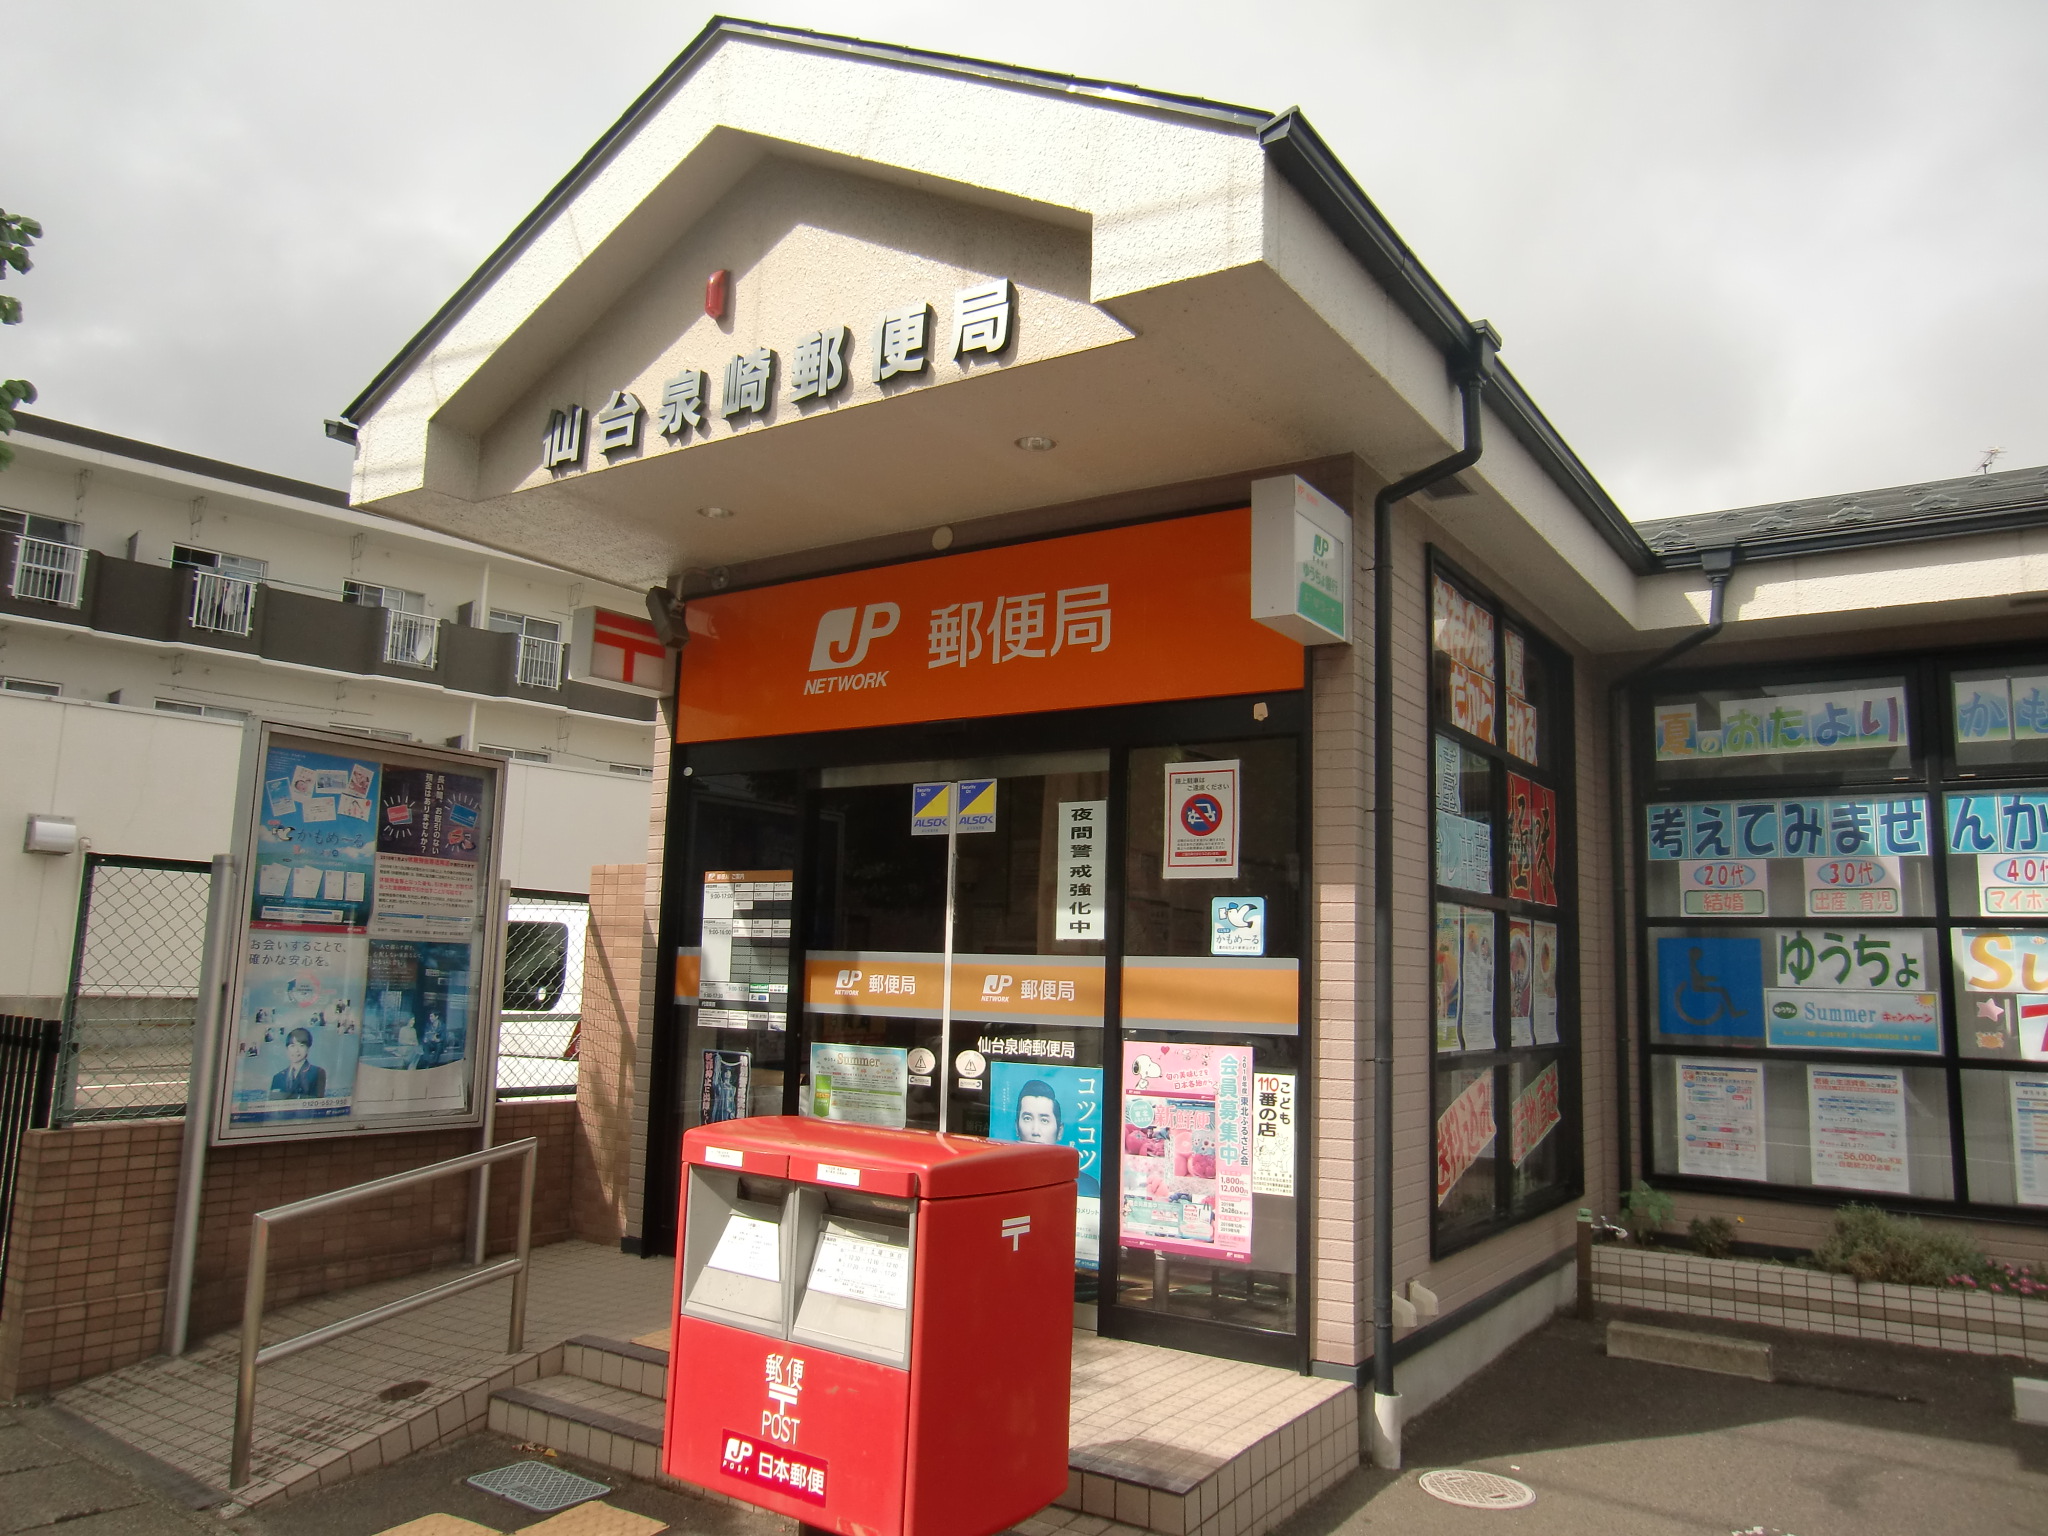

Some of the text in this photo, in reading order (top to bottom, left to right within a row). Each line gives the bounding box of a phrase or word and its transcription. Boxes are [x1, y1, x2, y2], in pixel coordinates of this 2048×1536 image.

[543, 278, 1013, 468] 仙台泉崎郵便局
[1302, 562, 1338, 596] ゆうちょ銀行
[928, 583, 1112, 669] 郵便局
[803, 671, 889, 696] NETWORK
[1658, 695, 1899, 755] 夏のおたより
[1175, 777, 1206, 785] 路上駐車は
[1187, 783, 1230, 792] ご遠慮ください
[432, 775, 446, 854] 長い間、お取引のない
[914, 818, 948, 828] ALSOK
[959, 815, 994, 825] ALSOK
[1069, 807, 1094, 934] 夜間警戒強化中
[1704, 863, 1745, 886] 20代
[1828, 861, 1874, 885] 30代
[1703, 891, 1745, 912] 結婚
[250, 939, 347, 953] お会いすることで、
[1216, 934, 1260, 945] かもめーる
[248, 953, 329, 967] 確かな安心を。
[1780, 931, 1920, 987] ゆうちょ
[868, 974, 916, 995] 郵便局
[1020, 979, 1075, 1002] 郵便局
[1804, 1001, 1876, 1023] Summer
[1882, 1012, 1933, 1023] キャンペーン
[977, 1035, 1075, 1059] 仙台泉崎郵便局
[837, 1053, 880, 1067] Summer
[1166, 1068, 1209, 1081] 旬の美味しさを
[1174, 1079, 1213, 1090] 日本各地から
[1218, 1054, 1239, 1166] 会員募集中
[1258, 1077, 1280, 1138] 110番の店
[1279, 1081, 1291, 1125] こども
[1077, 1078, 1097, 1171] コツコツ
[1154, 1104, 1211, 1130] 新鮮便
[1240, 1096, 1249, 1166] 東北ふるさと会
[765, 1353, 805, 1392] 郵便
[761, 1410, 800, 1446] POST
[722, 1460, 750, 1475] POST
[758, 1455, 825, 1497] 日本郵便
